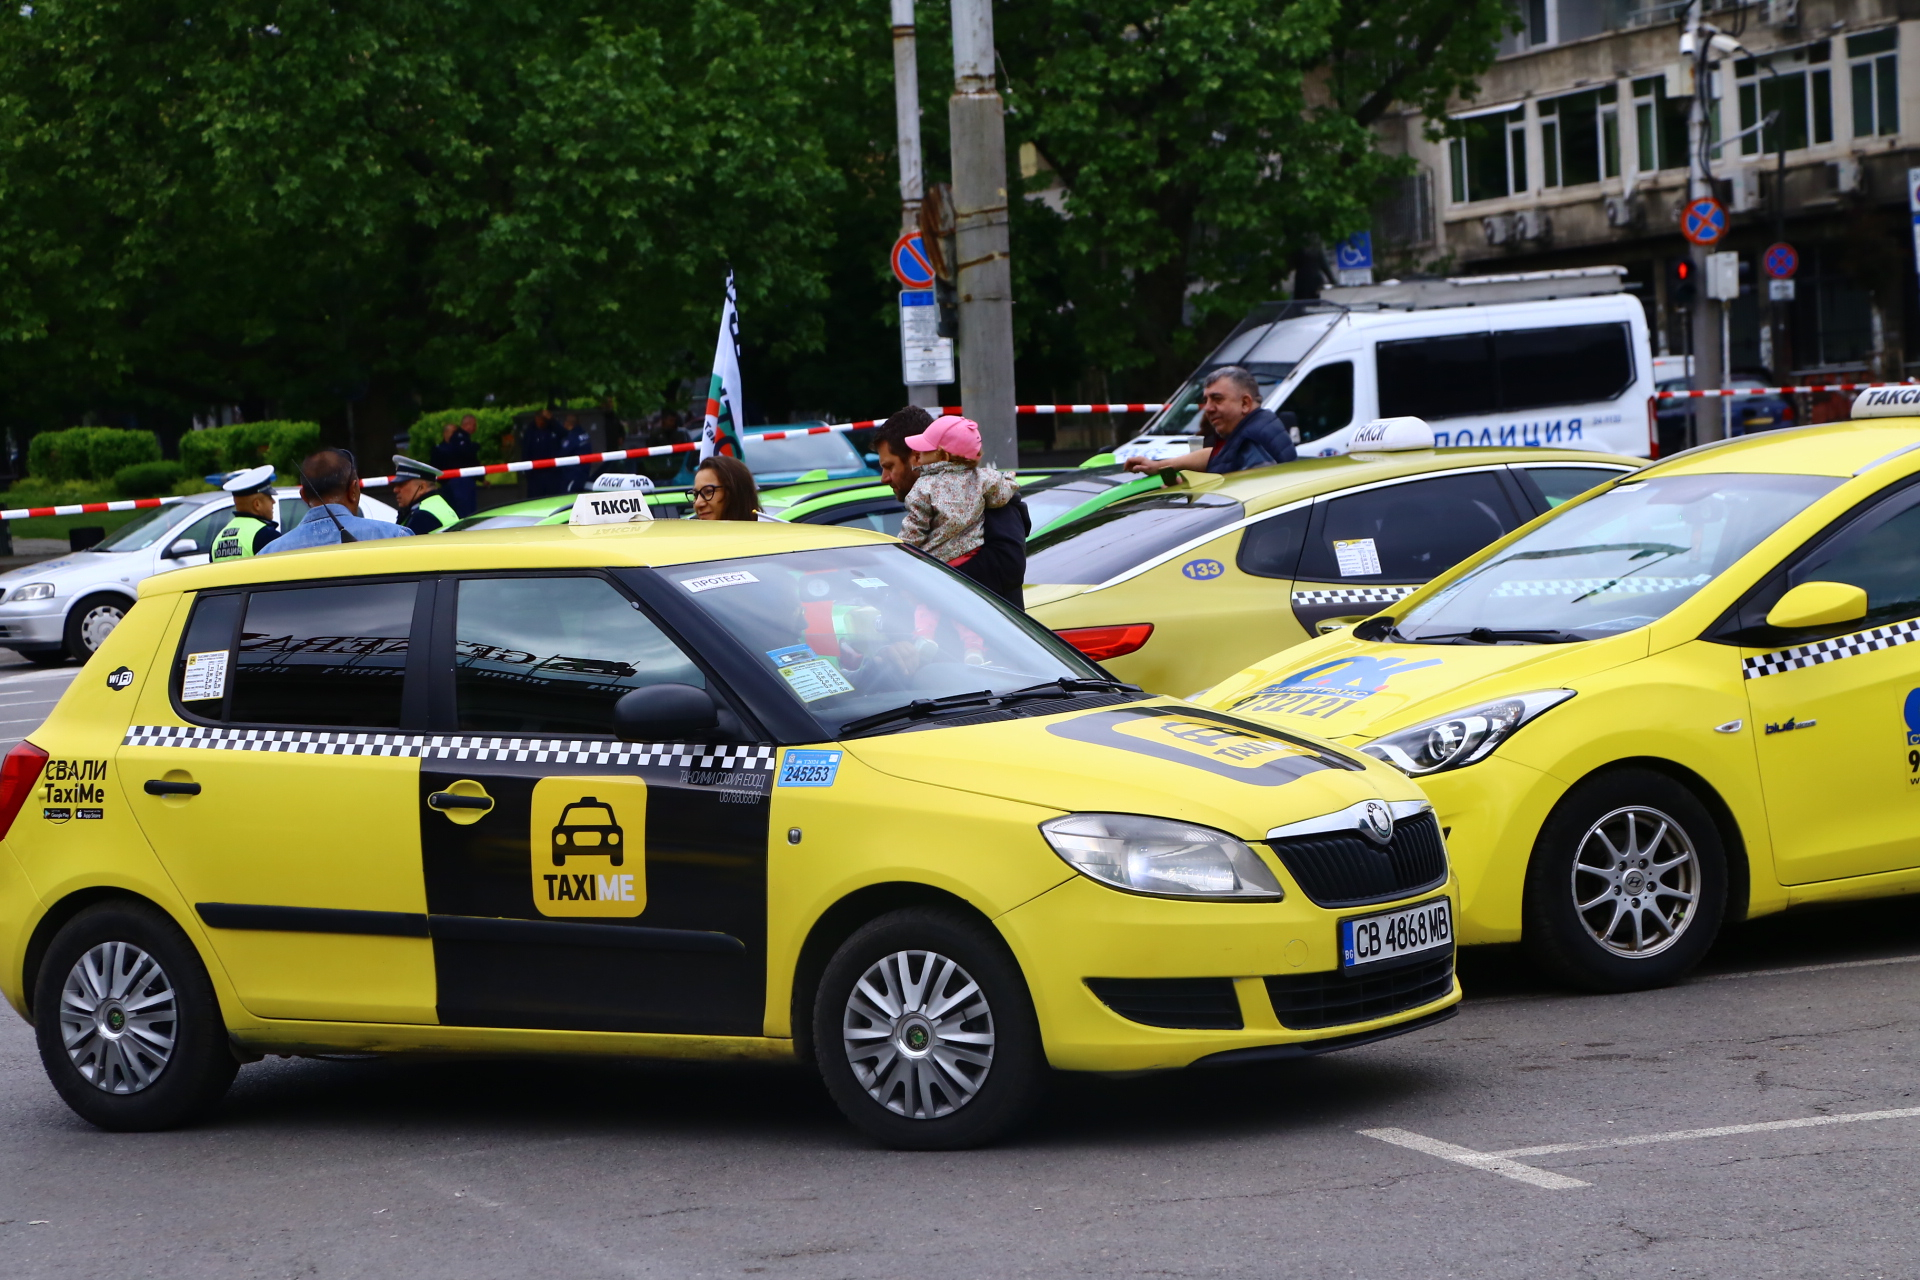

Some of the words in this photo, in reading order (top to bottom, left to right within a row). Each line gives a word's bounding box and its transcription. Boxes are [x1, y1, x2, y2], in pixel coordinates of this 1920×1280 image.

[1354, 423, 1391, 442] ТАКСИ
[1434, 418, 1583, 448] ПОЛИЦИЯ
[599, 477, 625, 488] ТАКСИ
[591, 498, 641, 516] ТАКСИ
[1186, 561, 1221, 578] 133
[692, 574, 747, 588] ПРОТЕСТ
[1261, 687, 1369, 698] СУПЕРТРАНС
[1765, 716, 1795, 735] blue
[46, 760, 107, 780] СВАЛИ
[784, 766, 830, 782] 245253
[716, 772, 743, 786] СОФИЯ
[743, 773, 766, 789] ЕООД
[45, 783, 104, 803] TaxiMe
[543, 875, 636, 901] TAXIME
[1356, 922, 1382, 958] CB
[1385, 912, 1428, 952] 4868
[1428, 906, 1449, 942] MB
[1345, 950, 1354, 960] BG
